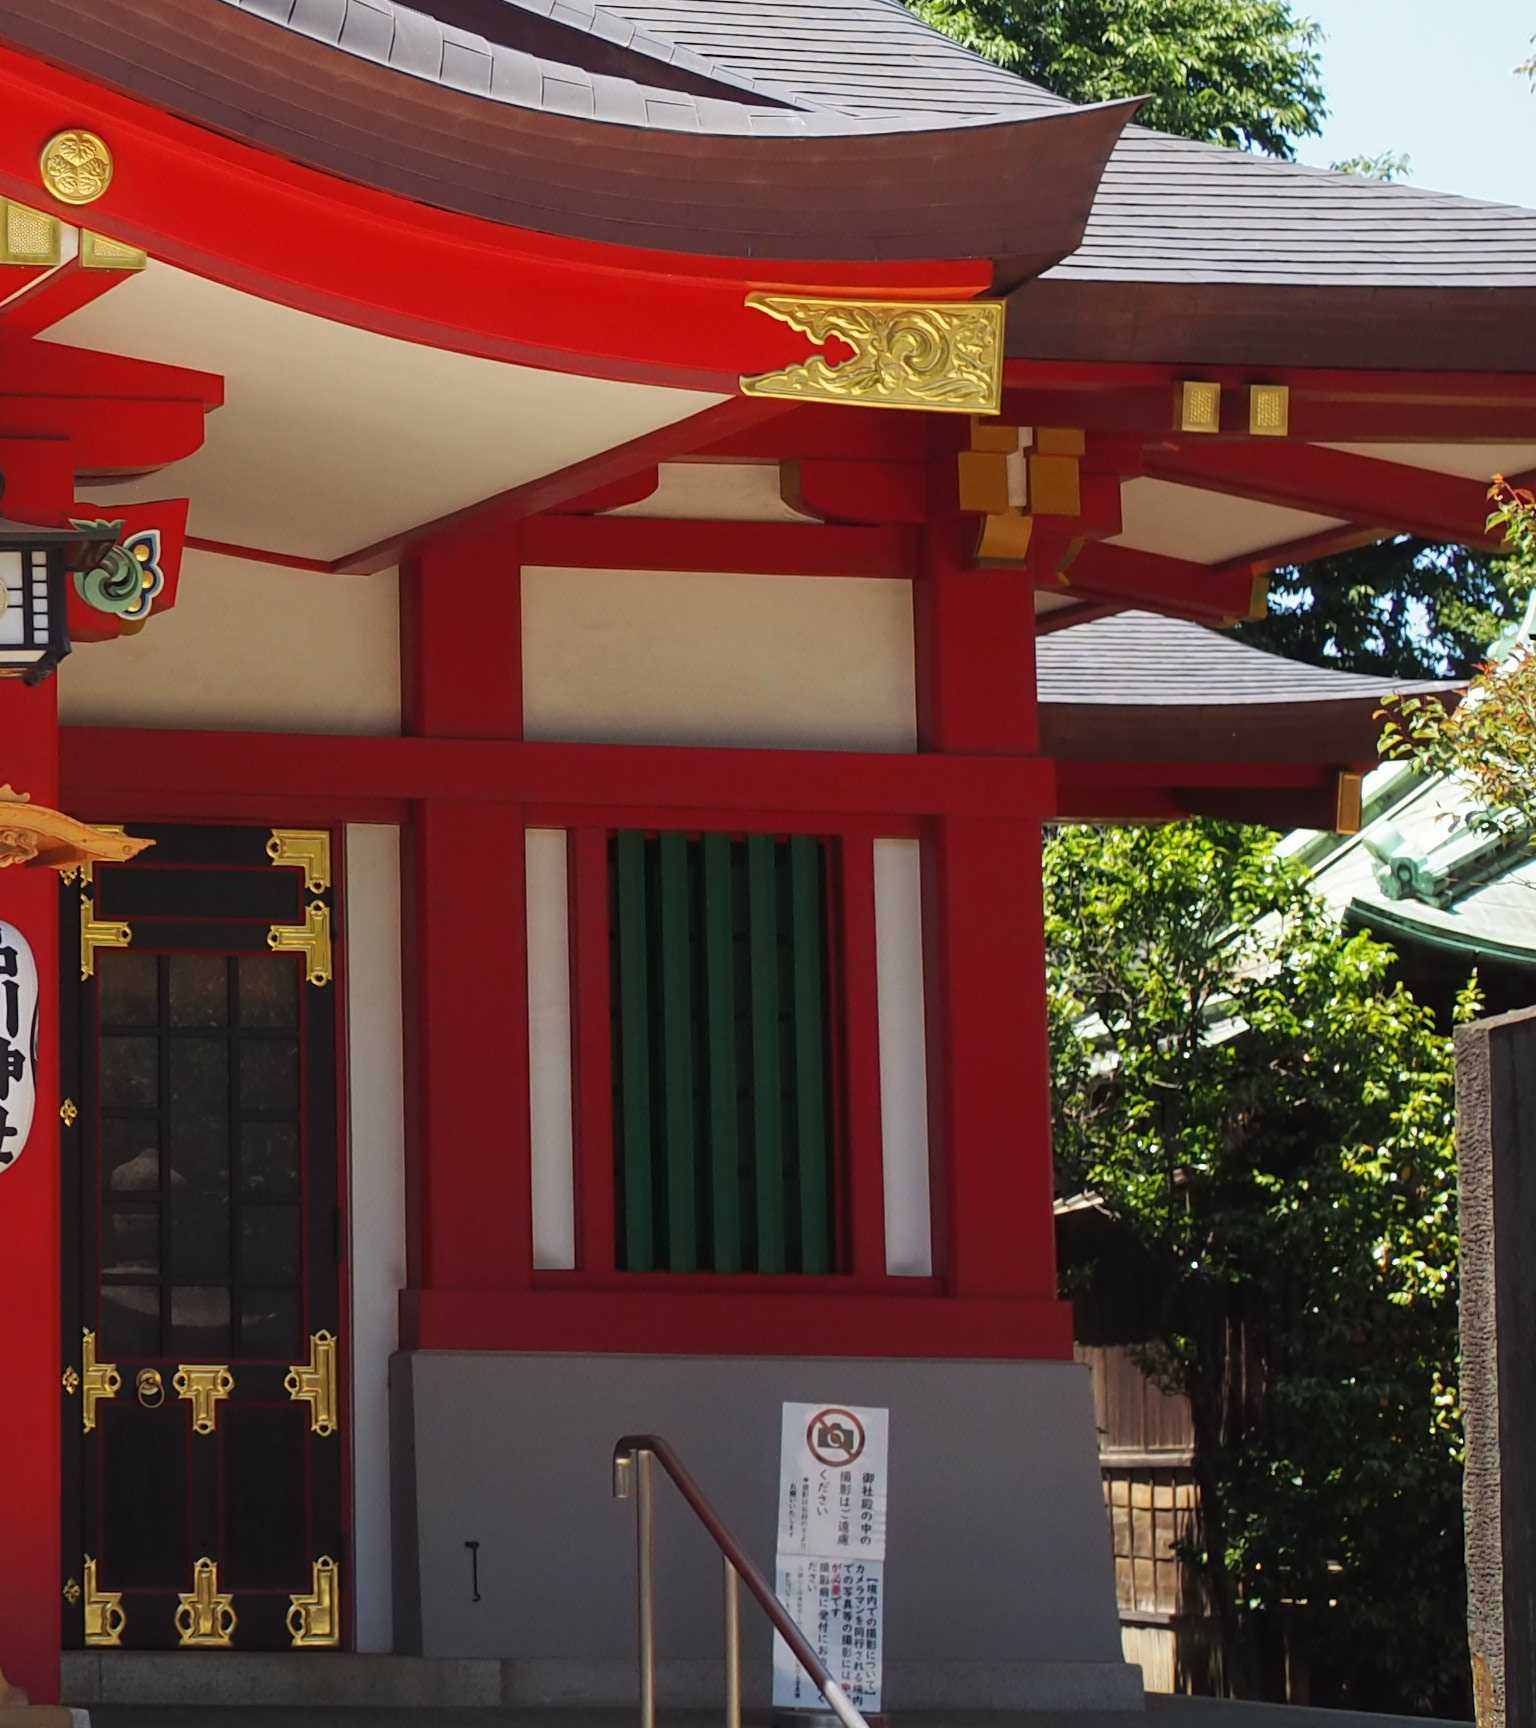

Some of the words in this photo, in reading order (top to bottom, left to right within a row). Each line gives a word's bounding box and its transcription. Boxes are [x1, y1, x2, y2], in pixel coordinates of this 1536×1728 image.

[816, 1469, 830, 1516] ください
[837, 1471, 852, 1546] 撮影はご遠慮
[860, 1472, 875, 1545] 御社殿の中の
